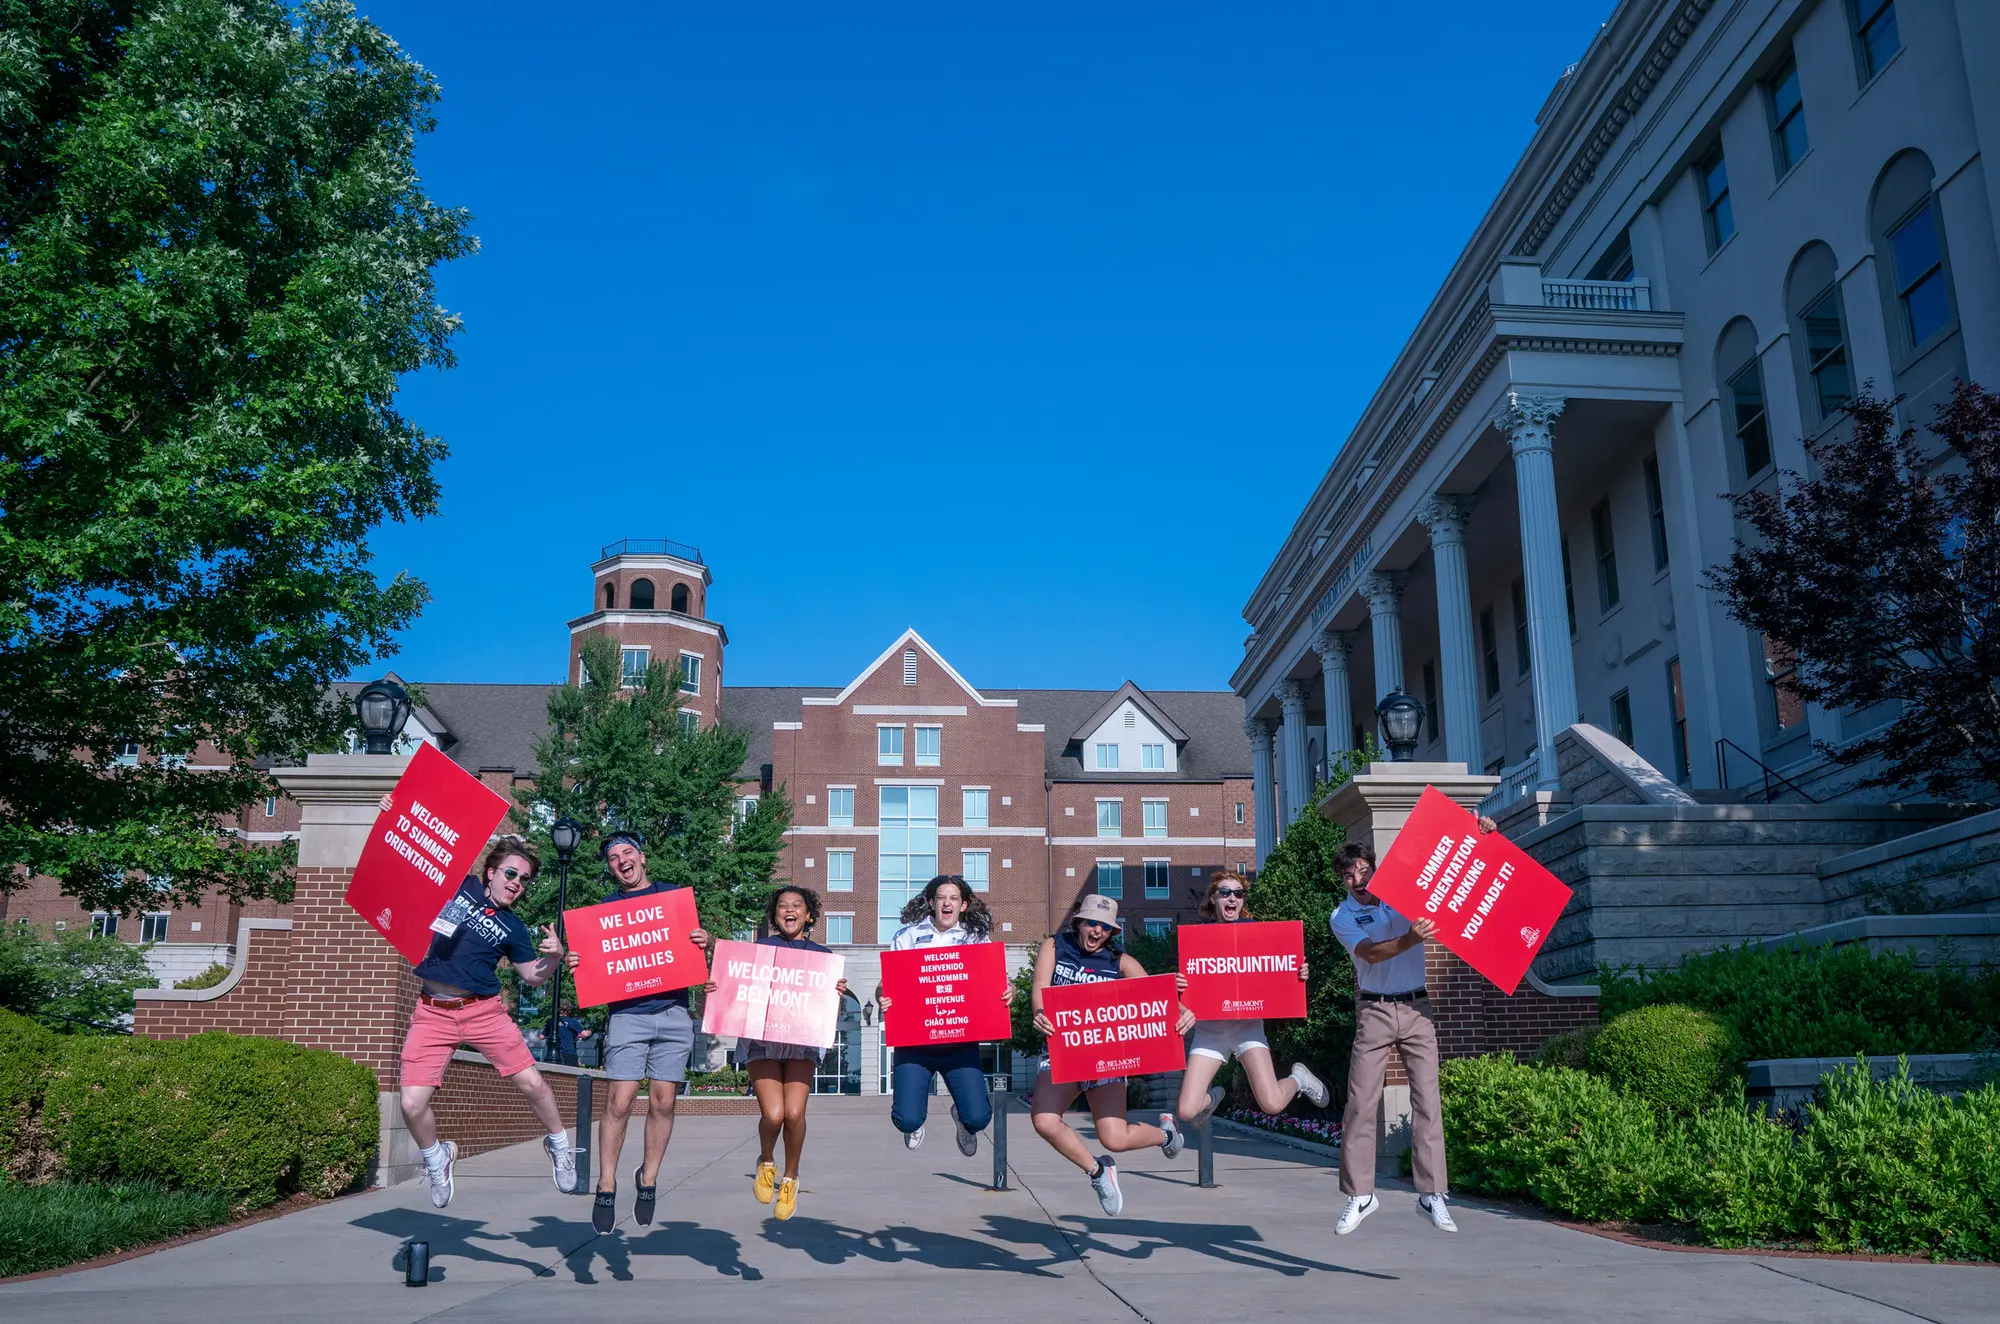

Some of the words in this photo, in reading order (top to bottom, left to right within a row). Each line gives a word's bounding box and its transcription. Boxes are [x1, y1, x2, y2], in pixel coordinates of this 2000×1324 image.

[1354, 535, 1374, 575] HALL
[410, 800, 460, 847] WELCOME
[396, 814, 411, 832] TO
[408, 826, 453, 867] SUMMER
[384, 830, 446, 887] ORIENTATION
[1416, 835, 1455, 890] SUMMER
[1425, 834, 1478, 913] ORIENTATION
[1447, 858, 1487, 913] PARKING
[1460, 913, 1484, 941] YOU
[1477, 877, 1506, 917] MADE
[1498, 861, 1515, 881] IT!
[454, 895, 508, 941] BELMONT
[599, 913, 624, 930] WE
[626, 906, 664, 925] LOVE
[601, 927, 670, 953] BELMONT
[606, 950, 674, 975] FAMILIES
[921, 962, 964, 973] BIENVENIDO
[924, 952, 960, 962] WELCOME
[1186, 954, 1298, 975] #ITSBRUINTIME
[634, 976, 662, 987] BELMONT
[728, 960, 805, 986] WELCOME
[807, 970, 827, 989] TO
[918, 973, 969, 984] WILLKOMMEN
[736, 984, 812, 1010] BELMONT
[925, 995, 965, 1005] BIENVENUE
[1084, 1008, 1095, 1025] A
[1096, 1003, 1138, 1023] GOOD
[1140, 1000, 1169, 1018] DAY
[1061, 1031, 1081, 1048] TO
[1083, 1028, 1103, 1046] BE
[1105, 1027, 1116, 1043] A
[1117, 1021, 1167, 1042] BRUIN!
[1106, 1057, 1141, 1067] BELMONT
